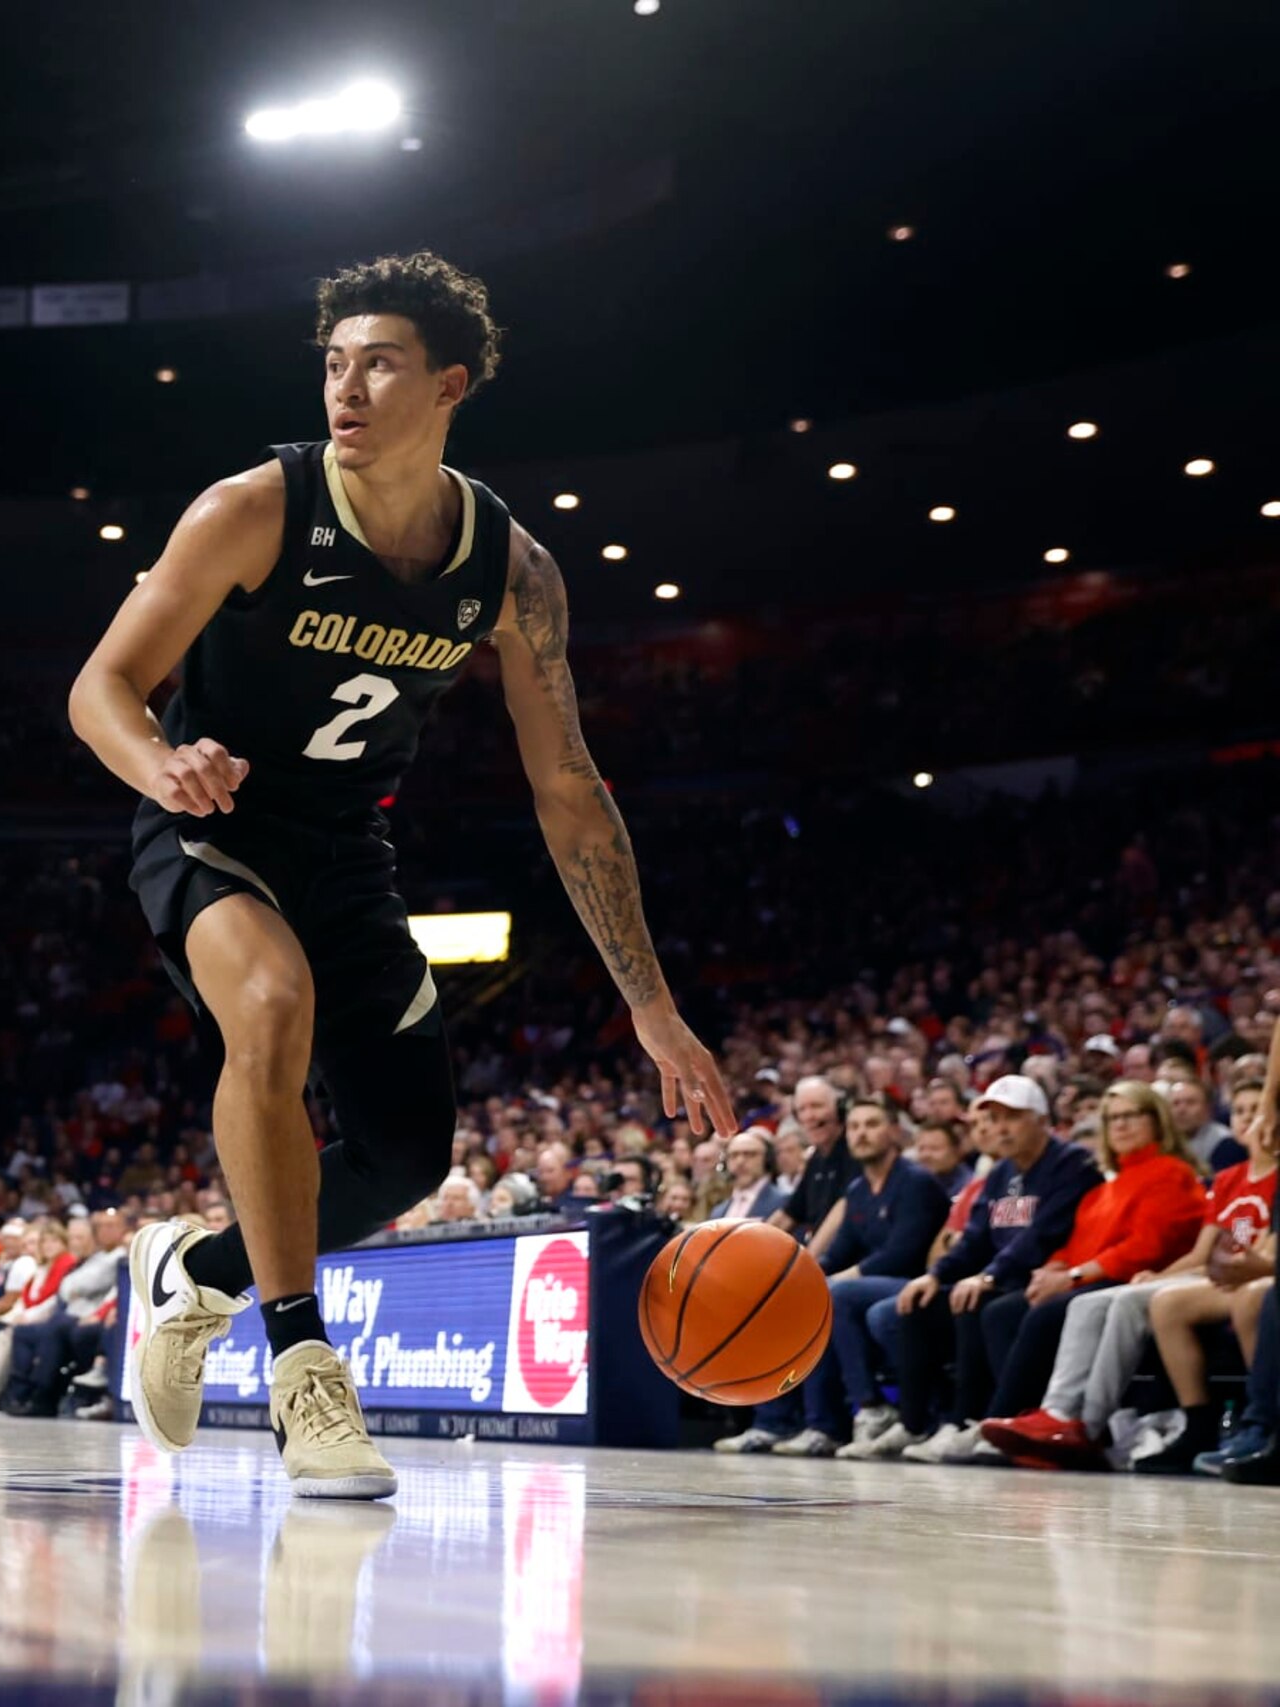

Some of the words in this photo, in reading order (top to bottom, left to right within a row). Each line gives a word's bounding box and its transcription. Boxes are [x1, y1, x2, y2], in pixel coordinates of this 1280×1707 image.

[310, 526, 336, 547] BH
[288, 609, 473, 671] COLORADO
[301, 672, 400, 761] 2
[322, 1266, 383, 1340] Way
[525, 1273, 578, 1321] Rite
[350, 1337, 371, 1387] &
[372, 1330, 496, 1403] Plumbing
[534, 1320, 589, 1377] Way
